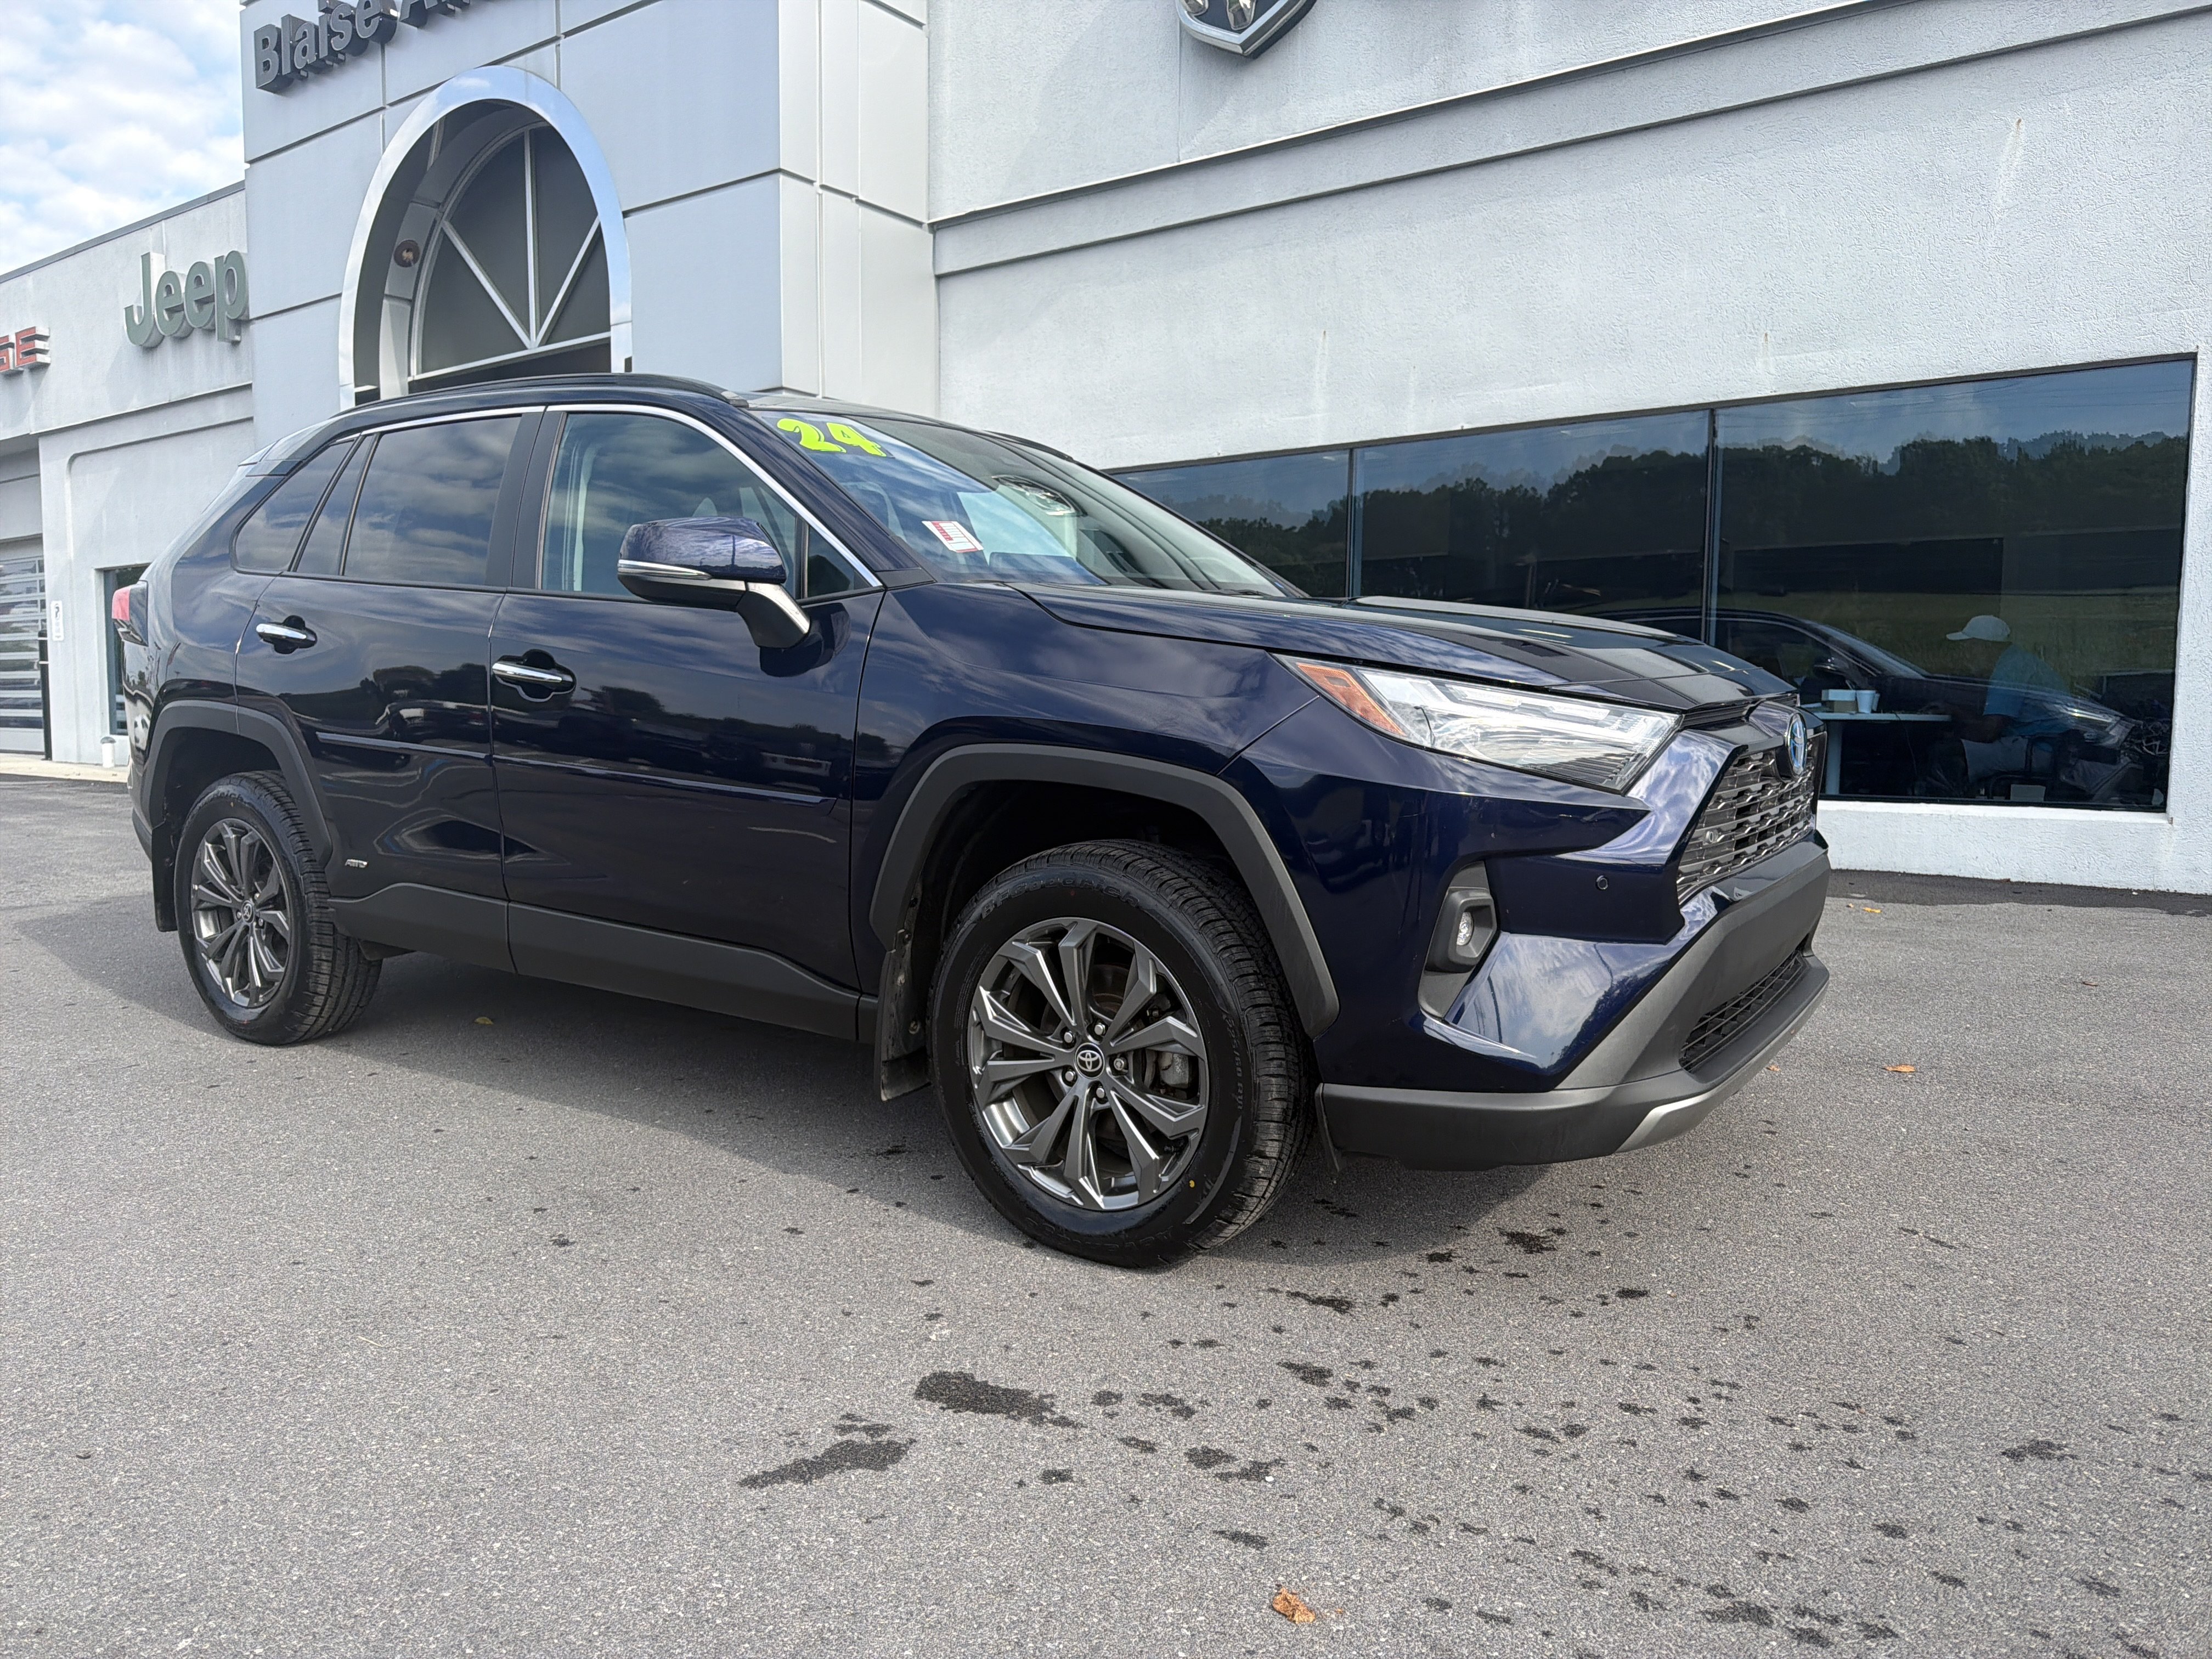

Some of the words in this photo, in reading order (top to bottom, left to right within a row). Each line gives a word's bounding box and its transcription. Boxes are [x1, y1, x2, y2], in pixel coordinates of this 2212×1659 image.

[253, 0, 392, 88] Blaise
[124, 251, 249, 347] Jeep
[777, 418, 887, 456] 24
